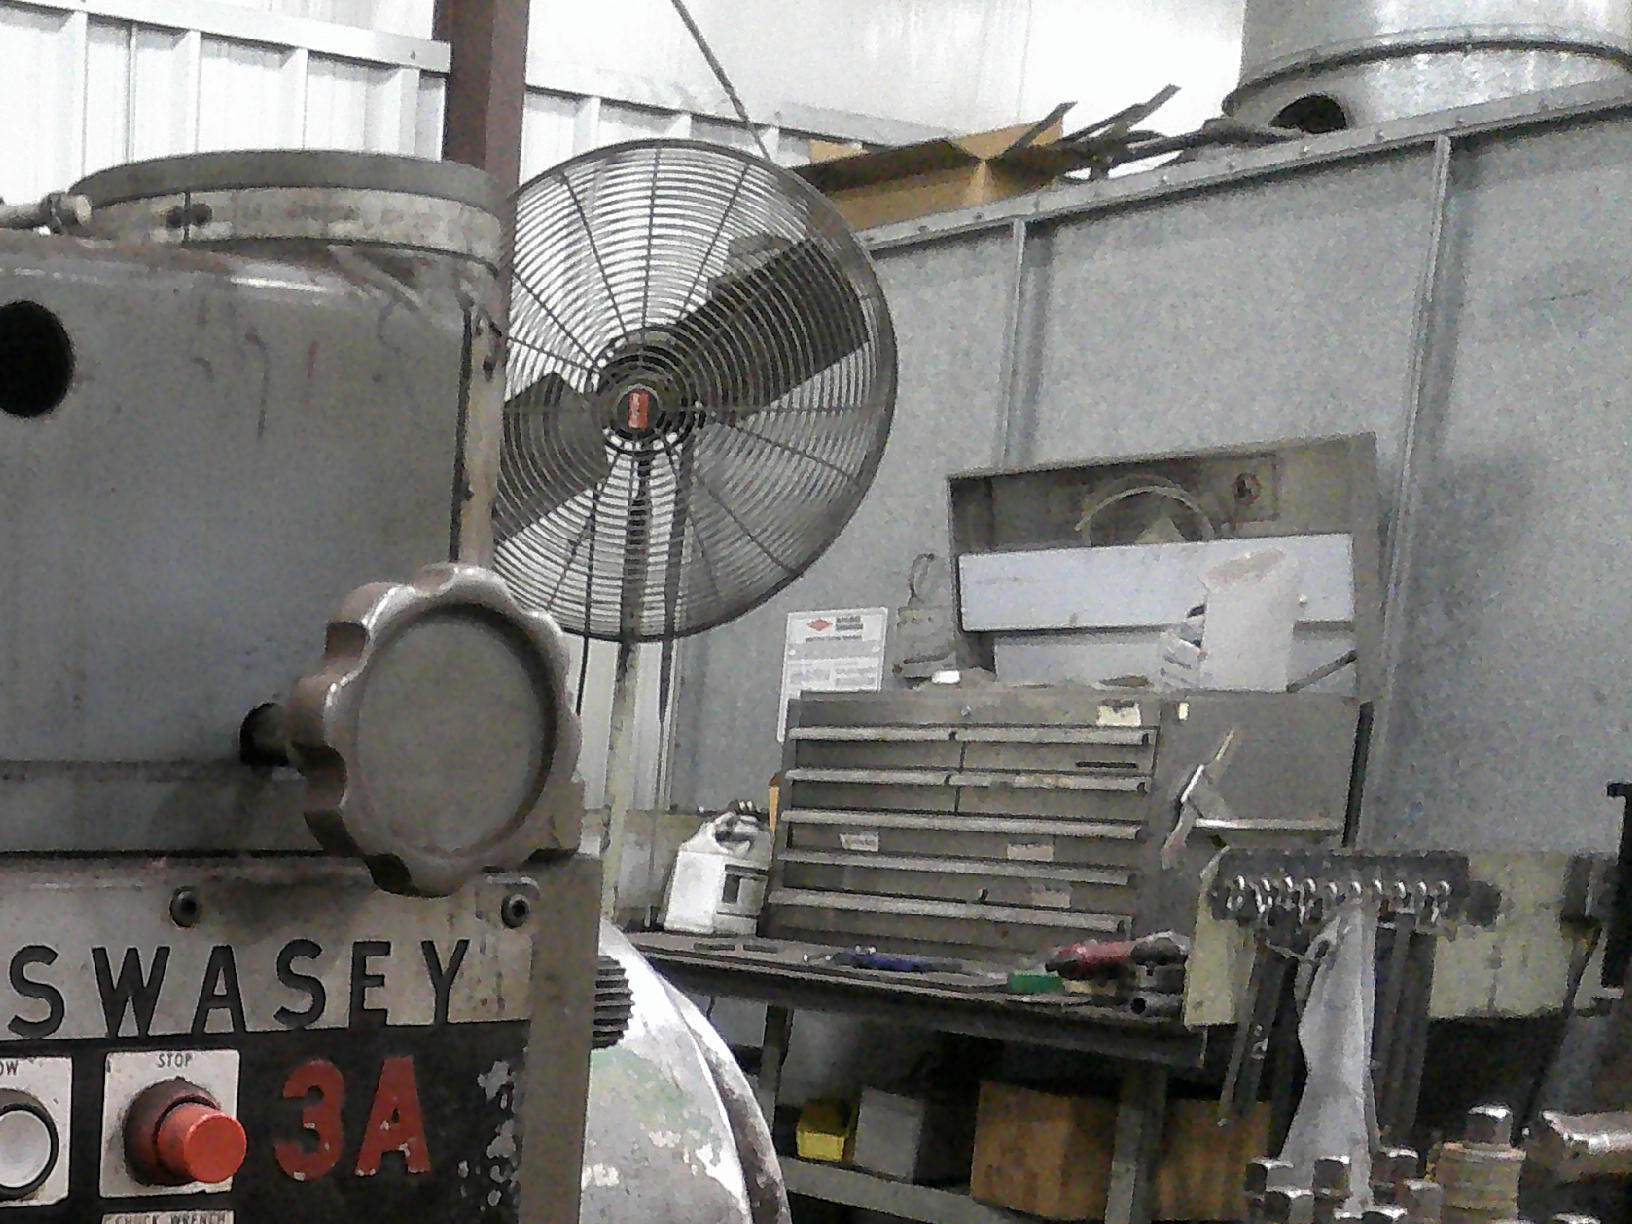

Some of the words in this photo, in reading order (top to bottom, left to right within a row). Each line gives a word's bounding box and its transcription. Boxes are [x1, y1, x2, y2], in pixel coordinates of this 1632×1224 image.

[8, 938, 470, 1040] SWASEY
[157, 1052, 193, 1069] STOP
[274, 1055, 432, 1181] 3A
